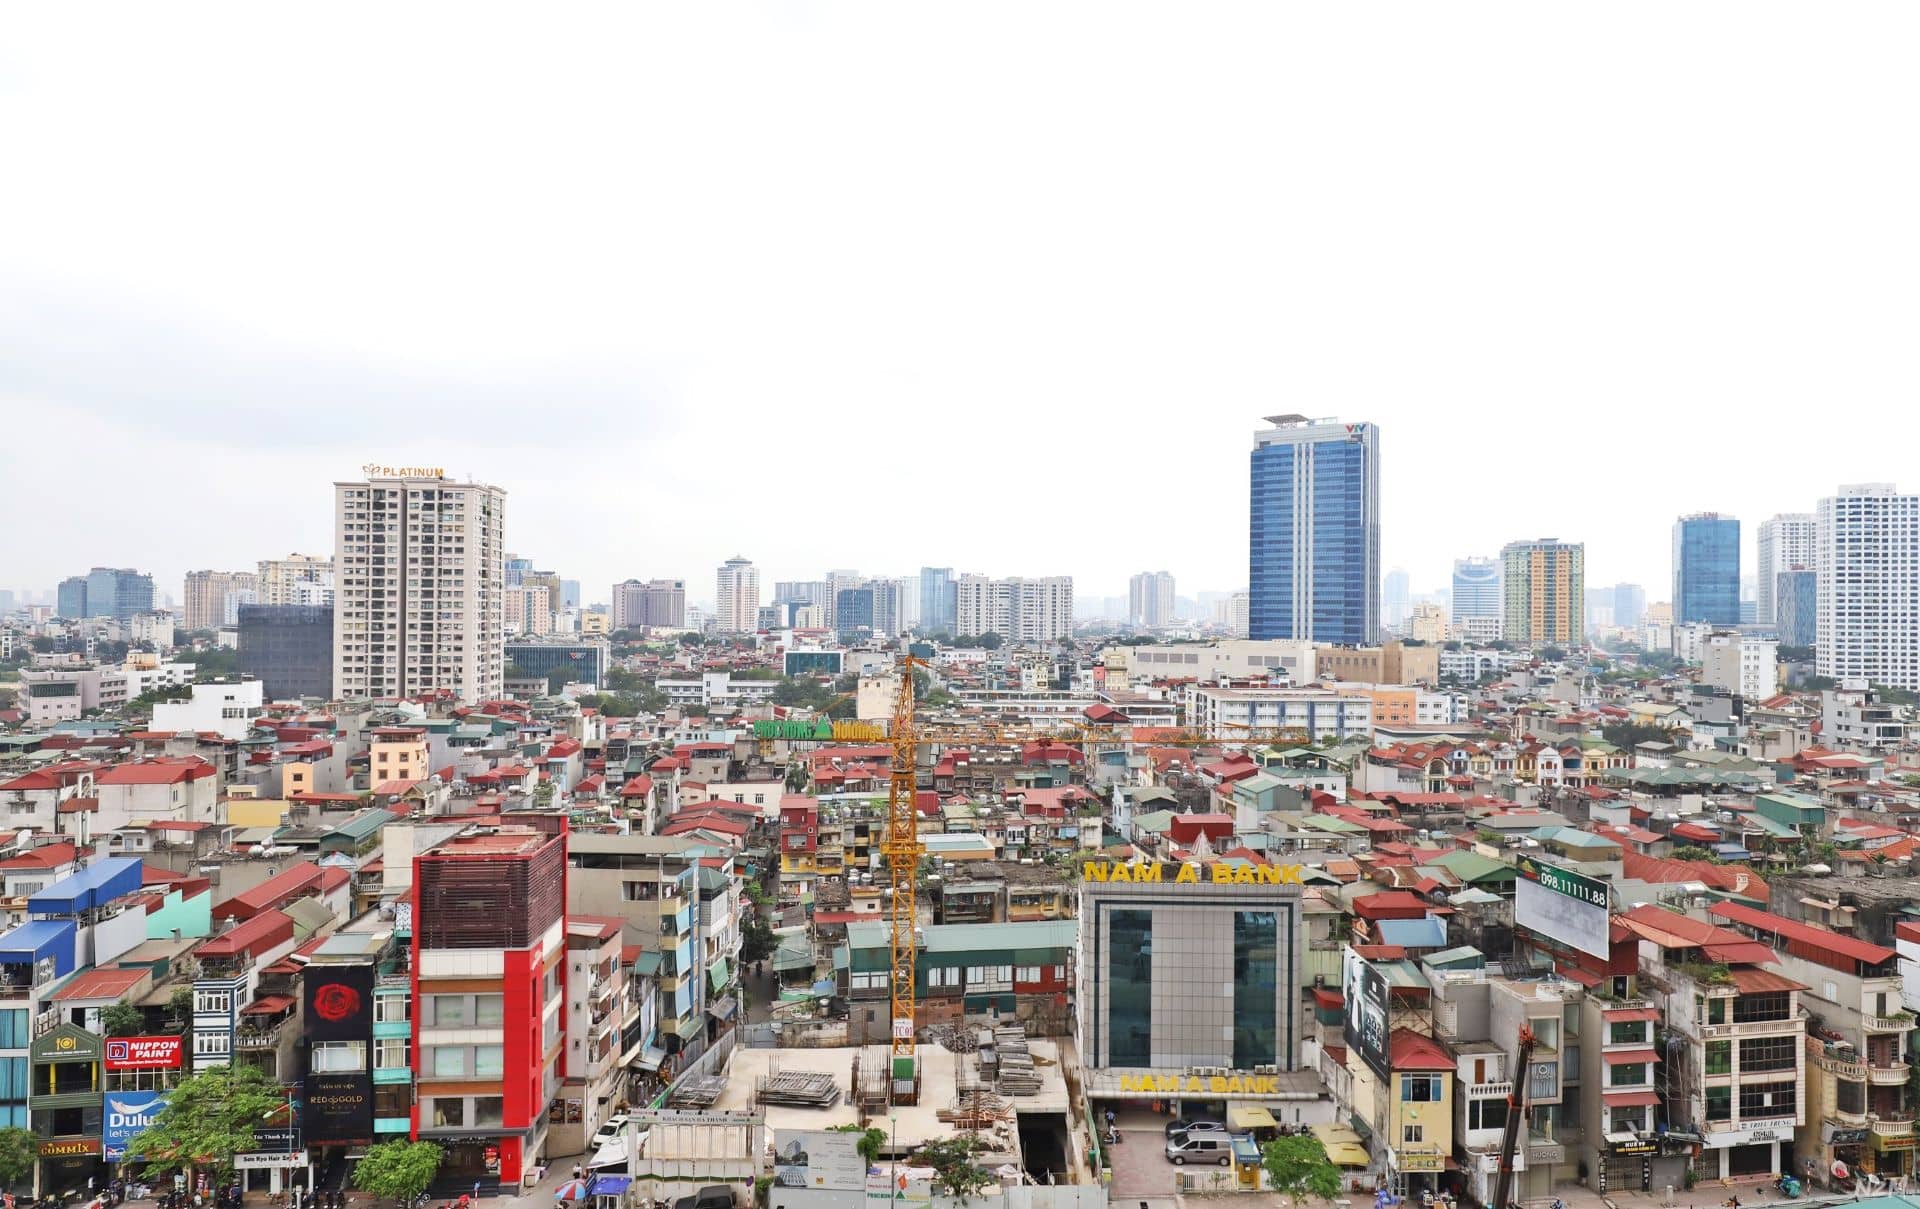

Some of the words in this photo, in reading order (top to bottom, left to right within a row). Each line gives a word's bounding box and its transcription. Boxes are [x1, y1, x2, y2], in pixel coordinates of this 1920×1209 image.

[1345, 424, 1366, 432] VTV
[383, 467, 444, 477] PLATINUM
[1084, 861, 1162, 883] NAM
[1175, 862, 1198, 884] A
[1212, 862, 1303, 885] BANK
[1541, 872, 1605, 905] 098.11111.88
[130, 1041, 178, 1050] NIPPON
[136, 1049, 172, 1058] PAINT
[1120, 1075, 1179, 1092] NAM
[1187, 1076, 1201, 1092] A
[1210, 1075, 1279, 1093] BANK
[310, 1096, 328, 1104] RED
[339, 1095, 362, 1103] GOLD
